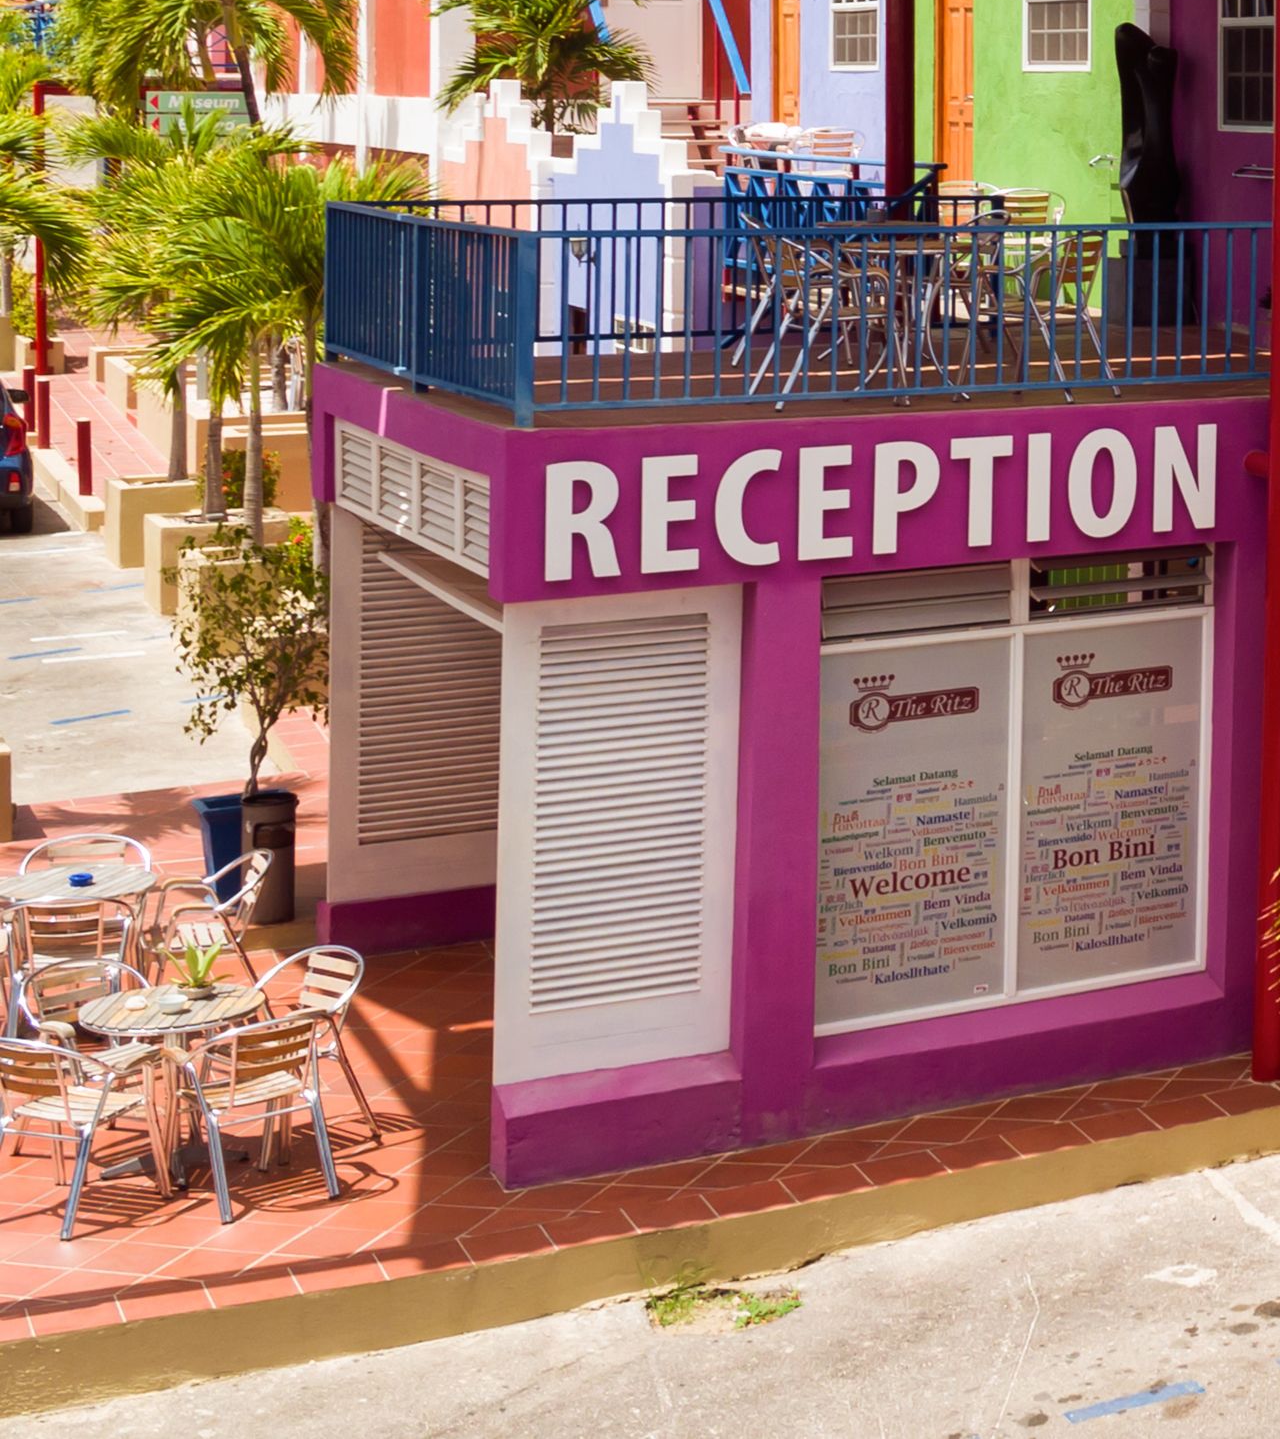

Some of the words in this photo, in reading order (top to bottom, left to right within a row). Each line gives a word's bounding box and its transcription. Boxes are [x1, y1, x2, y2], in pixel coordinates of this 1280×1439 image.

[168, 95, 239, 109] Mseum
[545, 423, 1218, 582] RECEPTION
[1091, 674, 1124, 695] The
[1127, 672, 1166, 694] Ritz
[891, 696, 926, 718] The
[930, 693, 973, 715] Ritz
[1074, 749, 1114, 762] Selamat
[1117, 744, 1153, 757] Datang
[873, 773, 916, 787] Selamat
[919, 769, 958, 783] Datang
[1114, 785, 1165, 800] Namaste
[916, 811, 971, 826] Namaste
[1120, 803, 1179, 820] Benvenuto
[1066, 817, 1112, 833] Welkom
[1097, 826, 1151, 842] Welcome
[923, 830, 986, 848] Benvenuto
[1038, 831, 1093, 848] Bienvenido
[863, 845, 914, 861] Welkom
[1052, 848, 1100, 871] Bon
[1108, 834, 1156, 862] Bini
[833, 861, 893, 877] Bienvenido
[899, 859, 926, 873] Bon
[931, 853, 959, 868] Bini
[1120, 868, 1146, 881] Bem
[1150, 862, 1183, 876] Vinda
[849, 866, 971, 899] Welcome
[1042, 878, 1110, 897] Velkommen
[923, 898, 951, 912] Bem
[955, 891, 991, 906] Vinda
[1136, 885, 1189, 902] Velkomið
[839, 909, 912, 928] Velkommen
[941, 913, 998, 931] Velkomið
[1064, 912, 1096, 924] Datang
[1033, 930, 1060, 944] Bon
[1064, 923, 1090, 939] Bini
[862, 943, 896, 956] Datang
[828, 963, 857, 977] Bon
[862, 955, 890, 972] Bini
